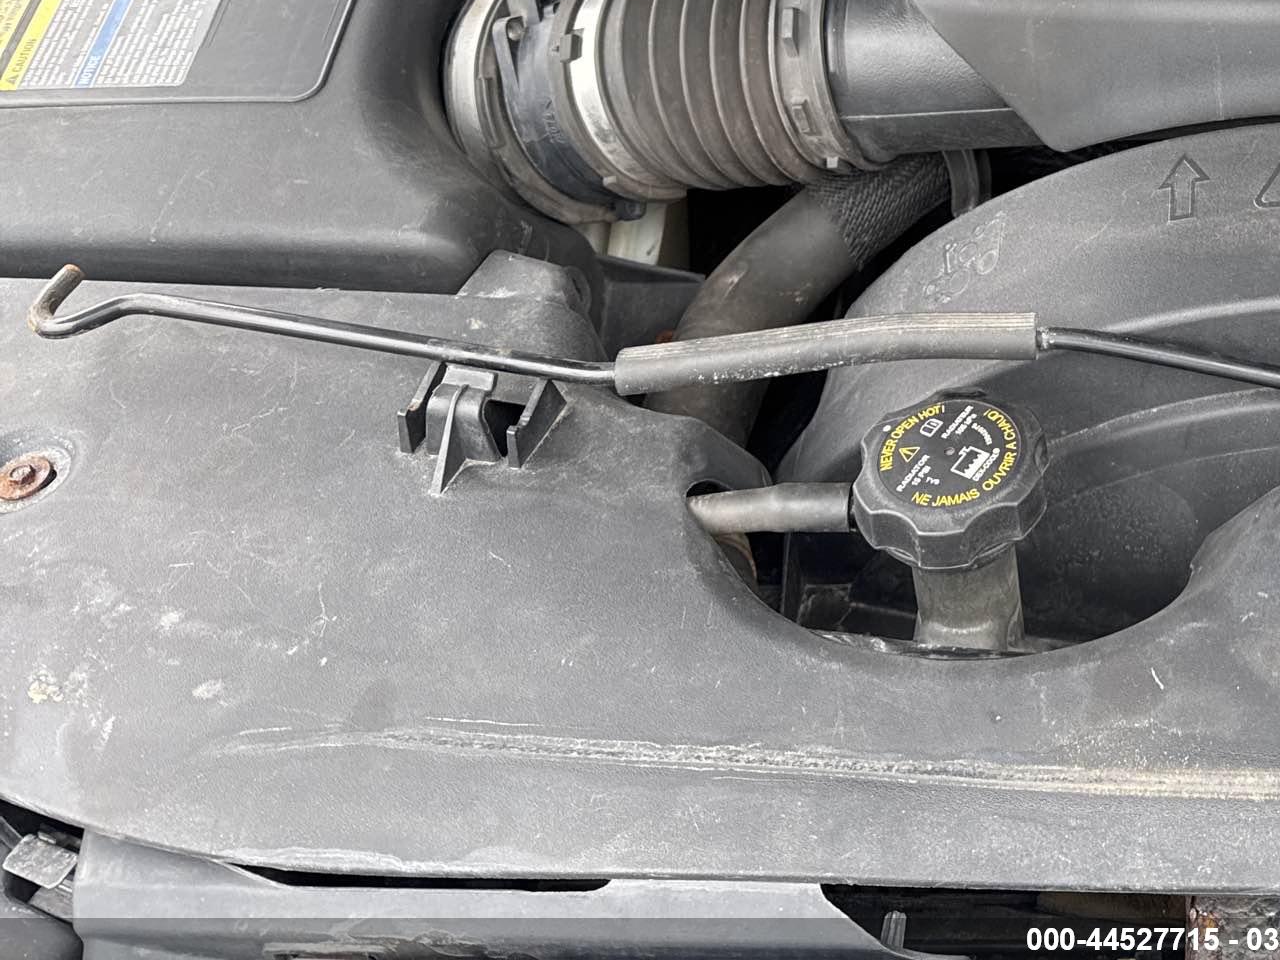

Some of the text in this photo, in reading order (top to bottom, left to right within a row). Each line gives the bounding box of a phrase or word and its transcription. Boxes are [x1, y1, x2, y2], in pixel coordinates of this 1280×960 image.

[14, 38, 38, 73] CAUTION
[79, 54, 101, 87] NOTICE
[983, 408, 1016, 440] CHAUD!
[880, 439, 897, 472] NEVER
[892, 416, 918, 444] OPEN
[896, 454, 930, 493] RADIATOR
[983, 451, 1018, 491] OUVRIR
[911, 491, 932, 506] NE
[932, 489, 980, 507] JAMAIS
